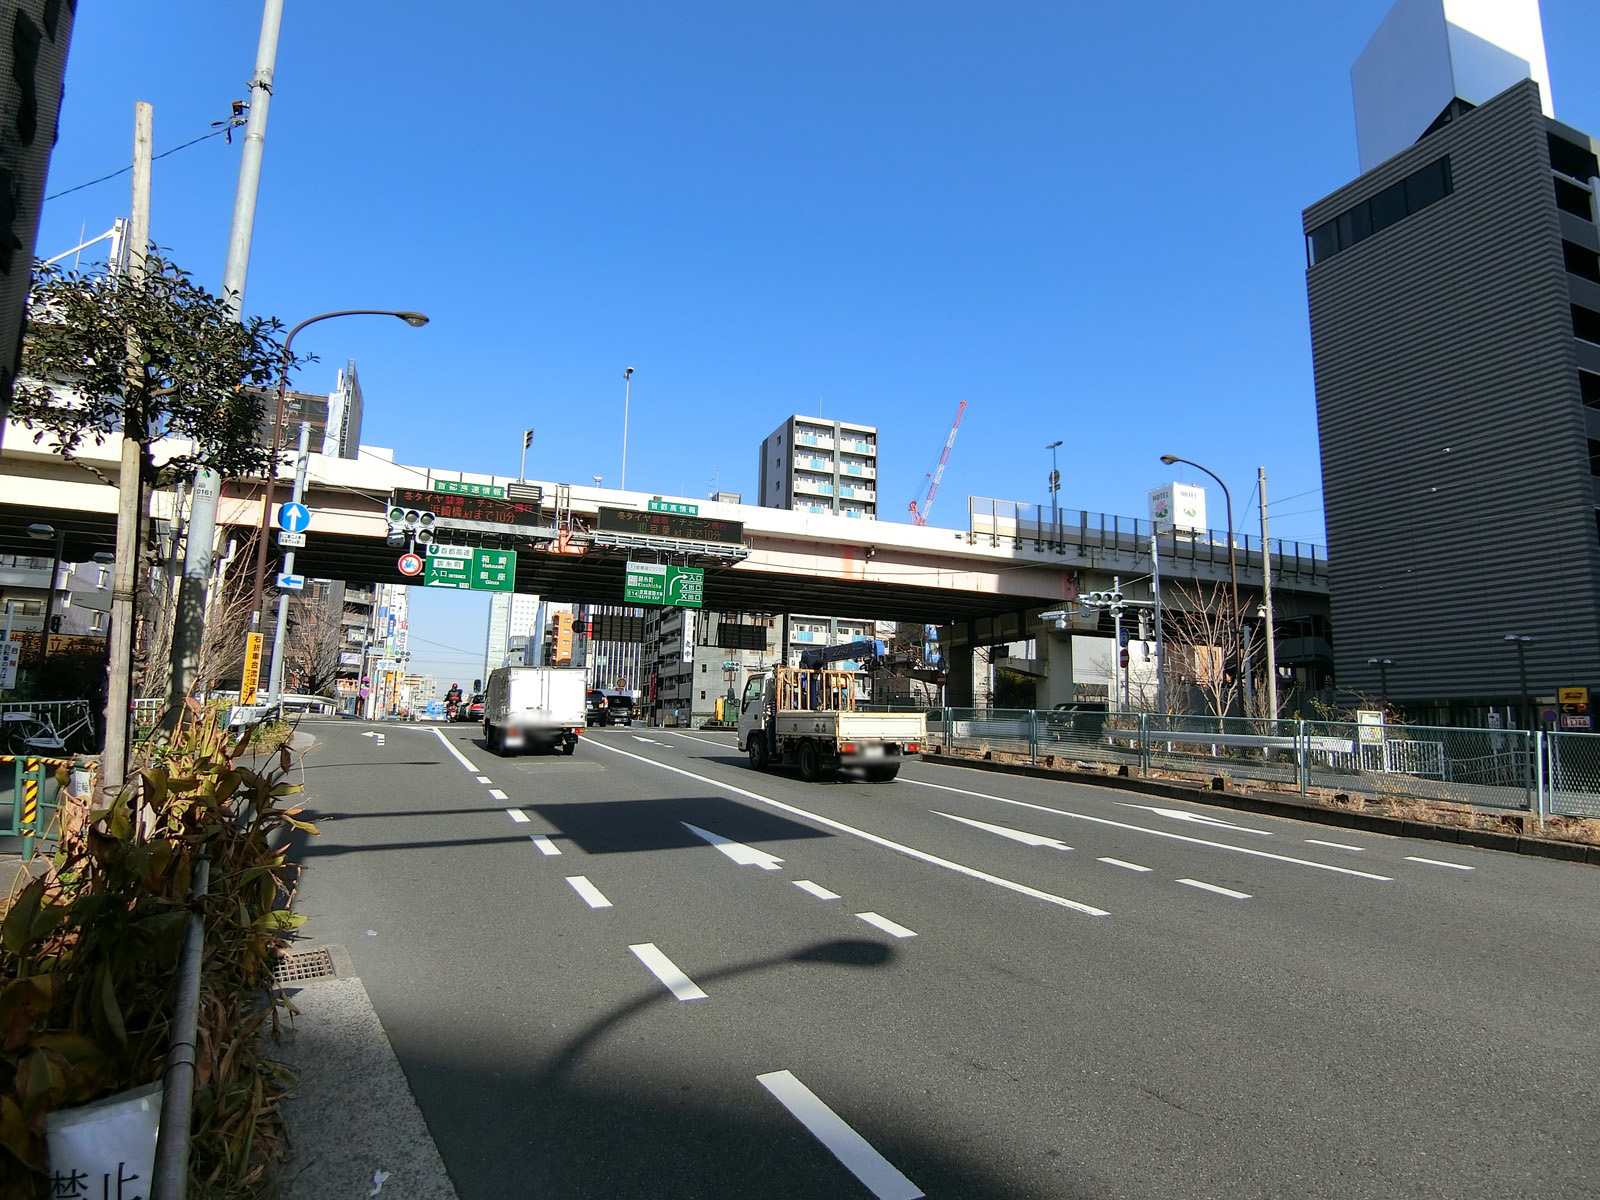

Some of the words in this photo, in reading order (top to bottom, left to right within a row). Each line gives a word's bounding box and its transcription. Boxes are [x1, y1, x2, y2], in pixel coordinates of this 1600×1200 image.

[196, 488, 213, 496] 0161
[437, 481, 503, 497] 首都高速情報
[1153, 491, 1169, 501] HOTEL
[1180, 491, 1197, 500] HOTEL
[650, 501, 697, 514] 首都高情報
[441, 547, 471, 557] 首都高速
[436, 560, 462, 568] 錦糸町
[482, 562, 506, 570] Hakozaki
[431, 569, 448, 578] 入口
[480, 571, 506, 581] 銀座
[688, 593, 701, 601] 出口
